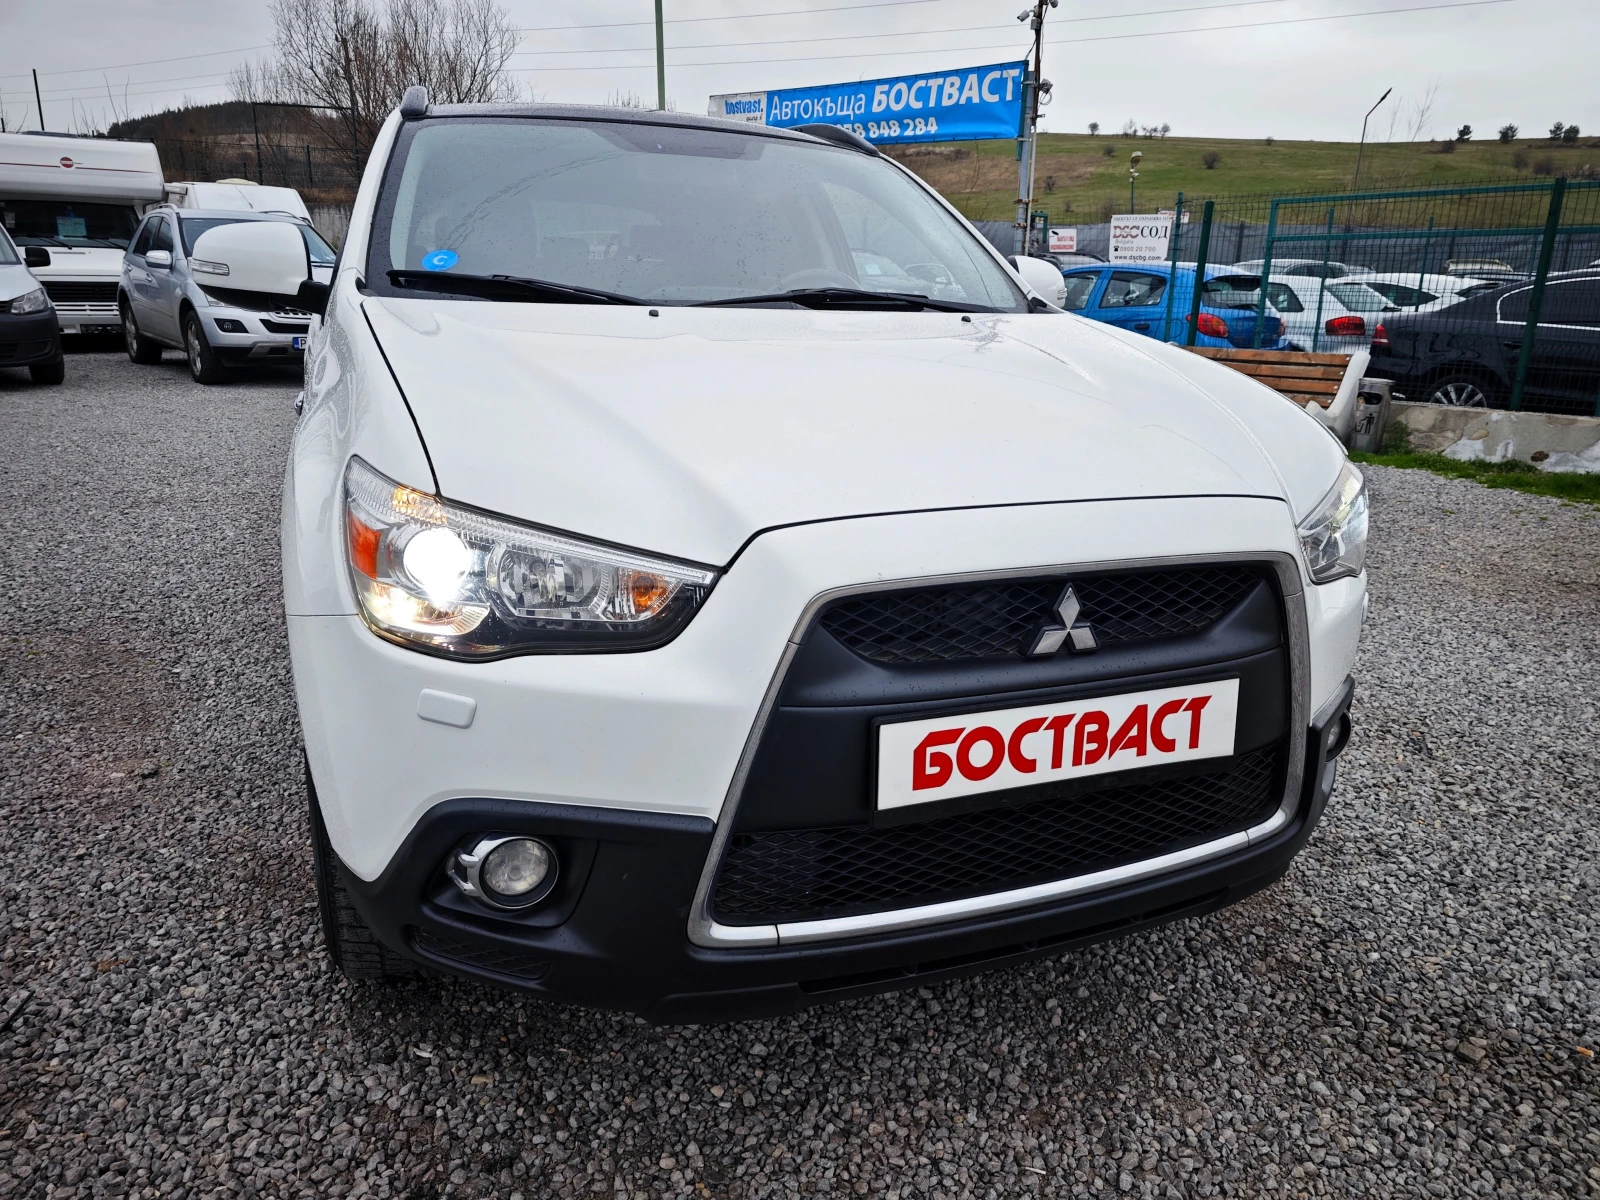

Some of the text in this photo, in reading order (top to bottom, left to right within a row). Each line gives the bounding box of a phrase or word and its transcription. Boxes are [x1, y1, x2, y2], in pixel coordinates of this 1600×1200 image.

[769, 69, 1020, 120] Автокъща БОСТВАСТ
[867, 120, 901, 139] 848
[902, 117, 938, 136] 284
[1140, 225, 1169, 240] СОД
[912, 695, 1213, 791] БОСТВАСТ
